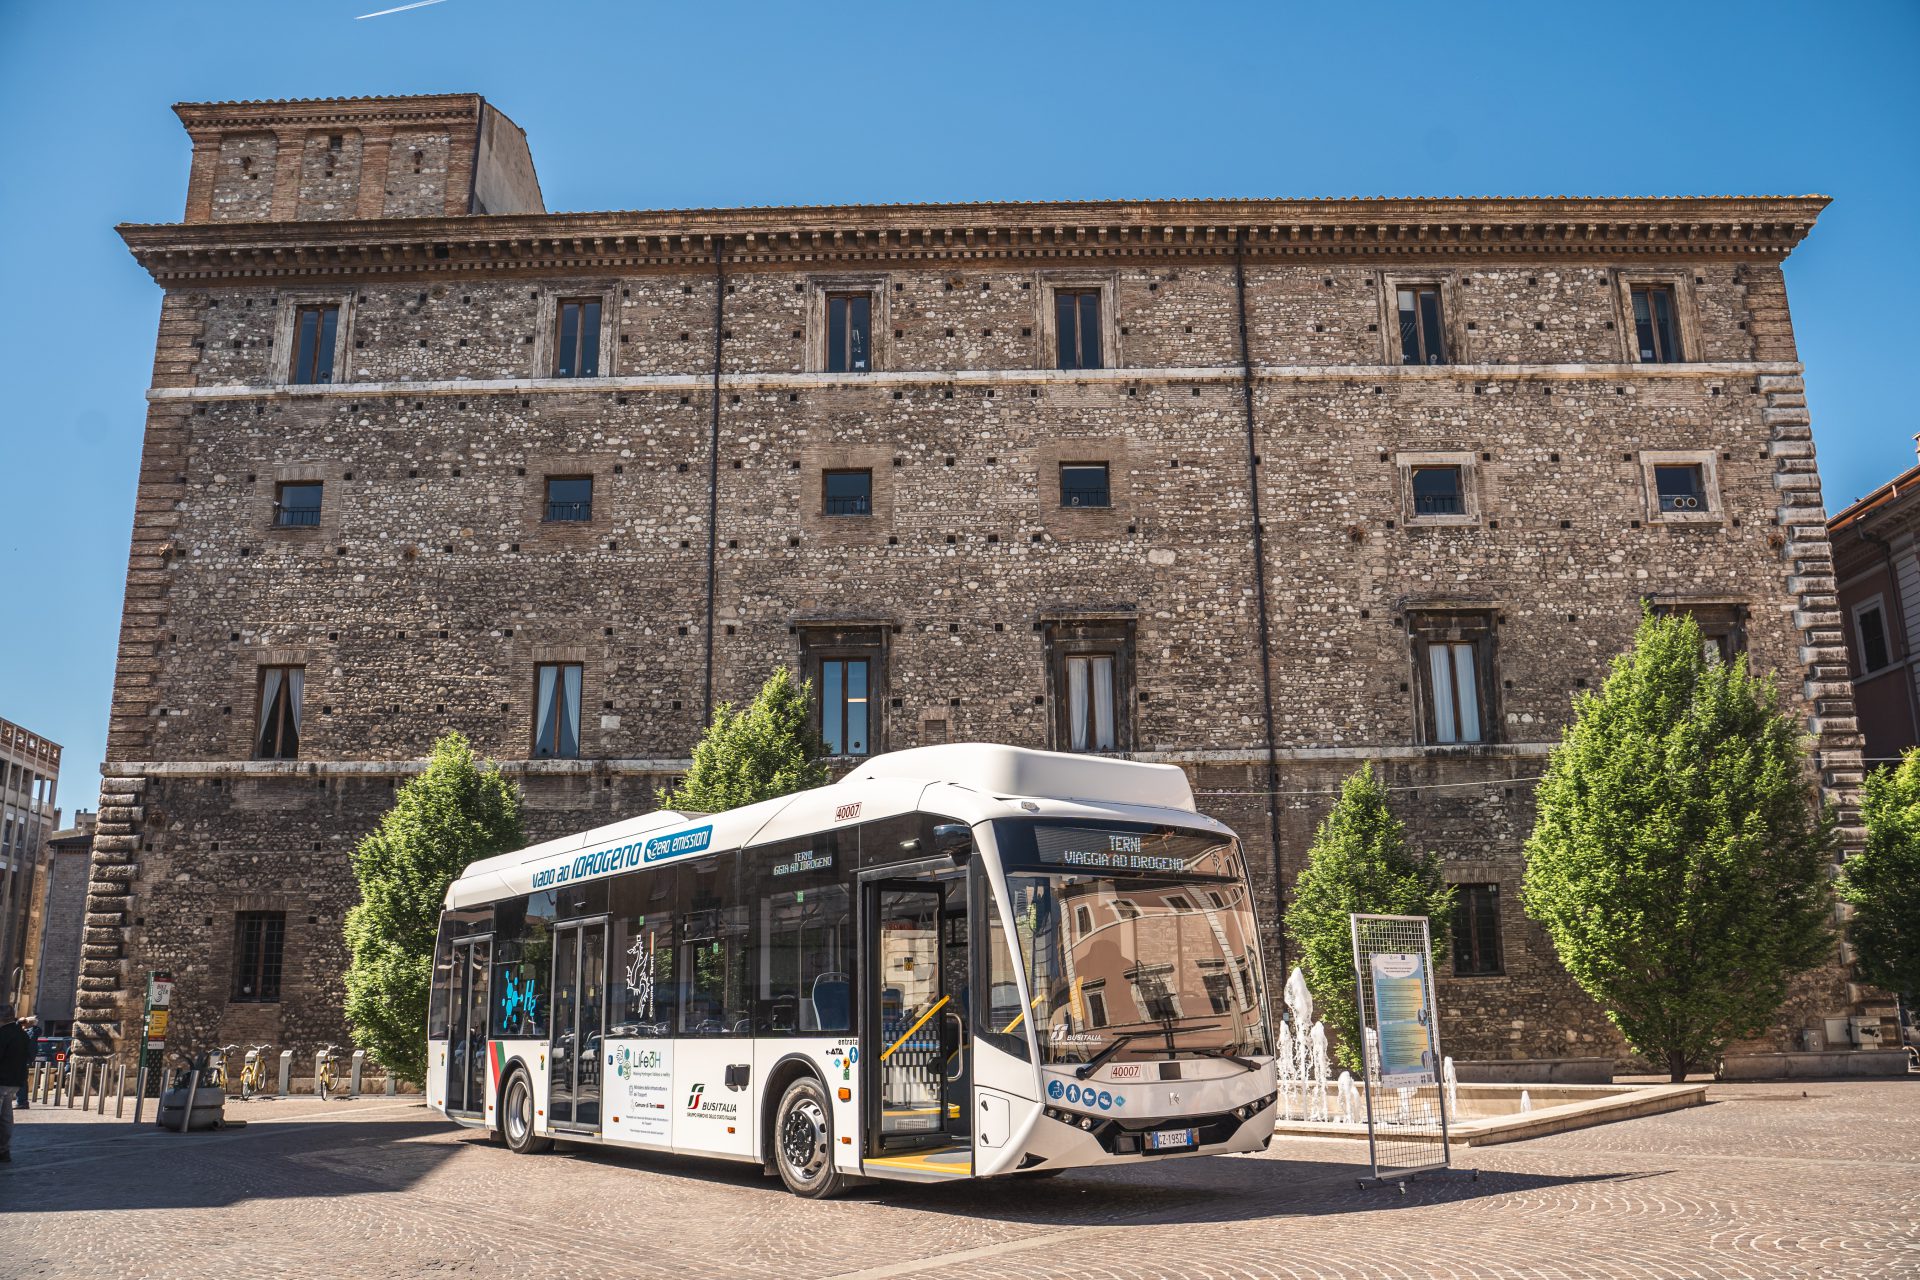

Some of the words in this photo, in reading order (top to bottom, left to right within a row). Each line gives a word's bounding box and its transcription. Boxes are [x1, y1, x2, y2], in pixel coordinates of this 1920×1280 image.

[836, 804, 859, 819] 40007
[1109, 836, 1140, 852] TERNI
[1064, 851, 1109, 866] VIAGGIA
[1112, 854, 1128, 868] AD
[1130, 855, 1184, 871] IDROGENO
[1113, 1066, 1139, 1077] 40007
[702, 1101, 737, 1113] BUSITALIA
